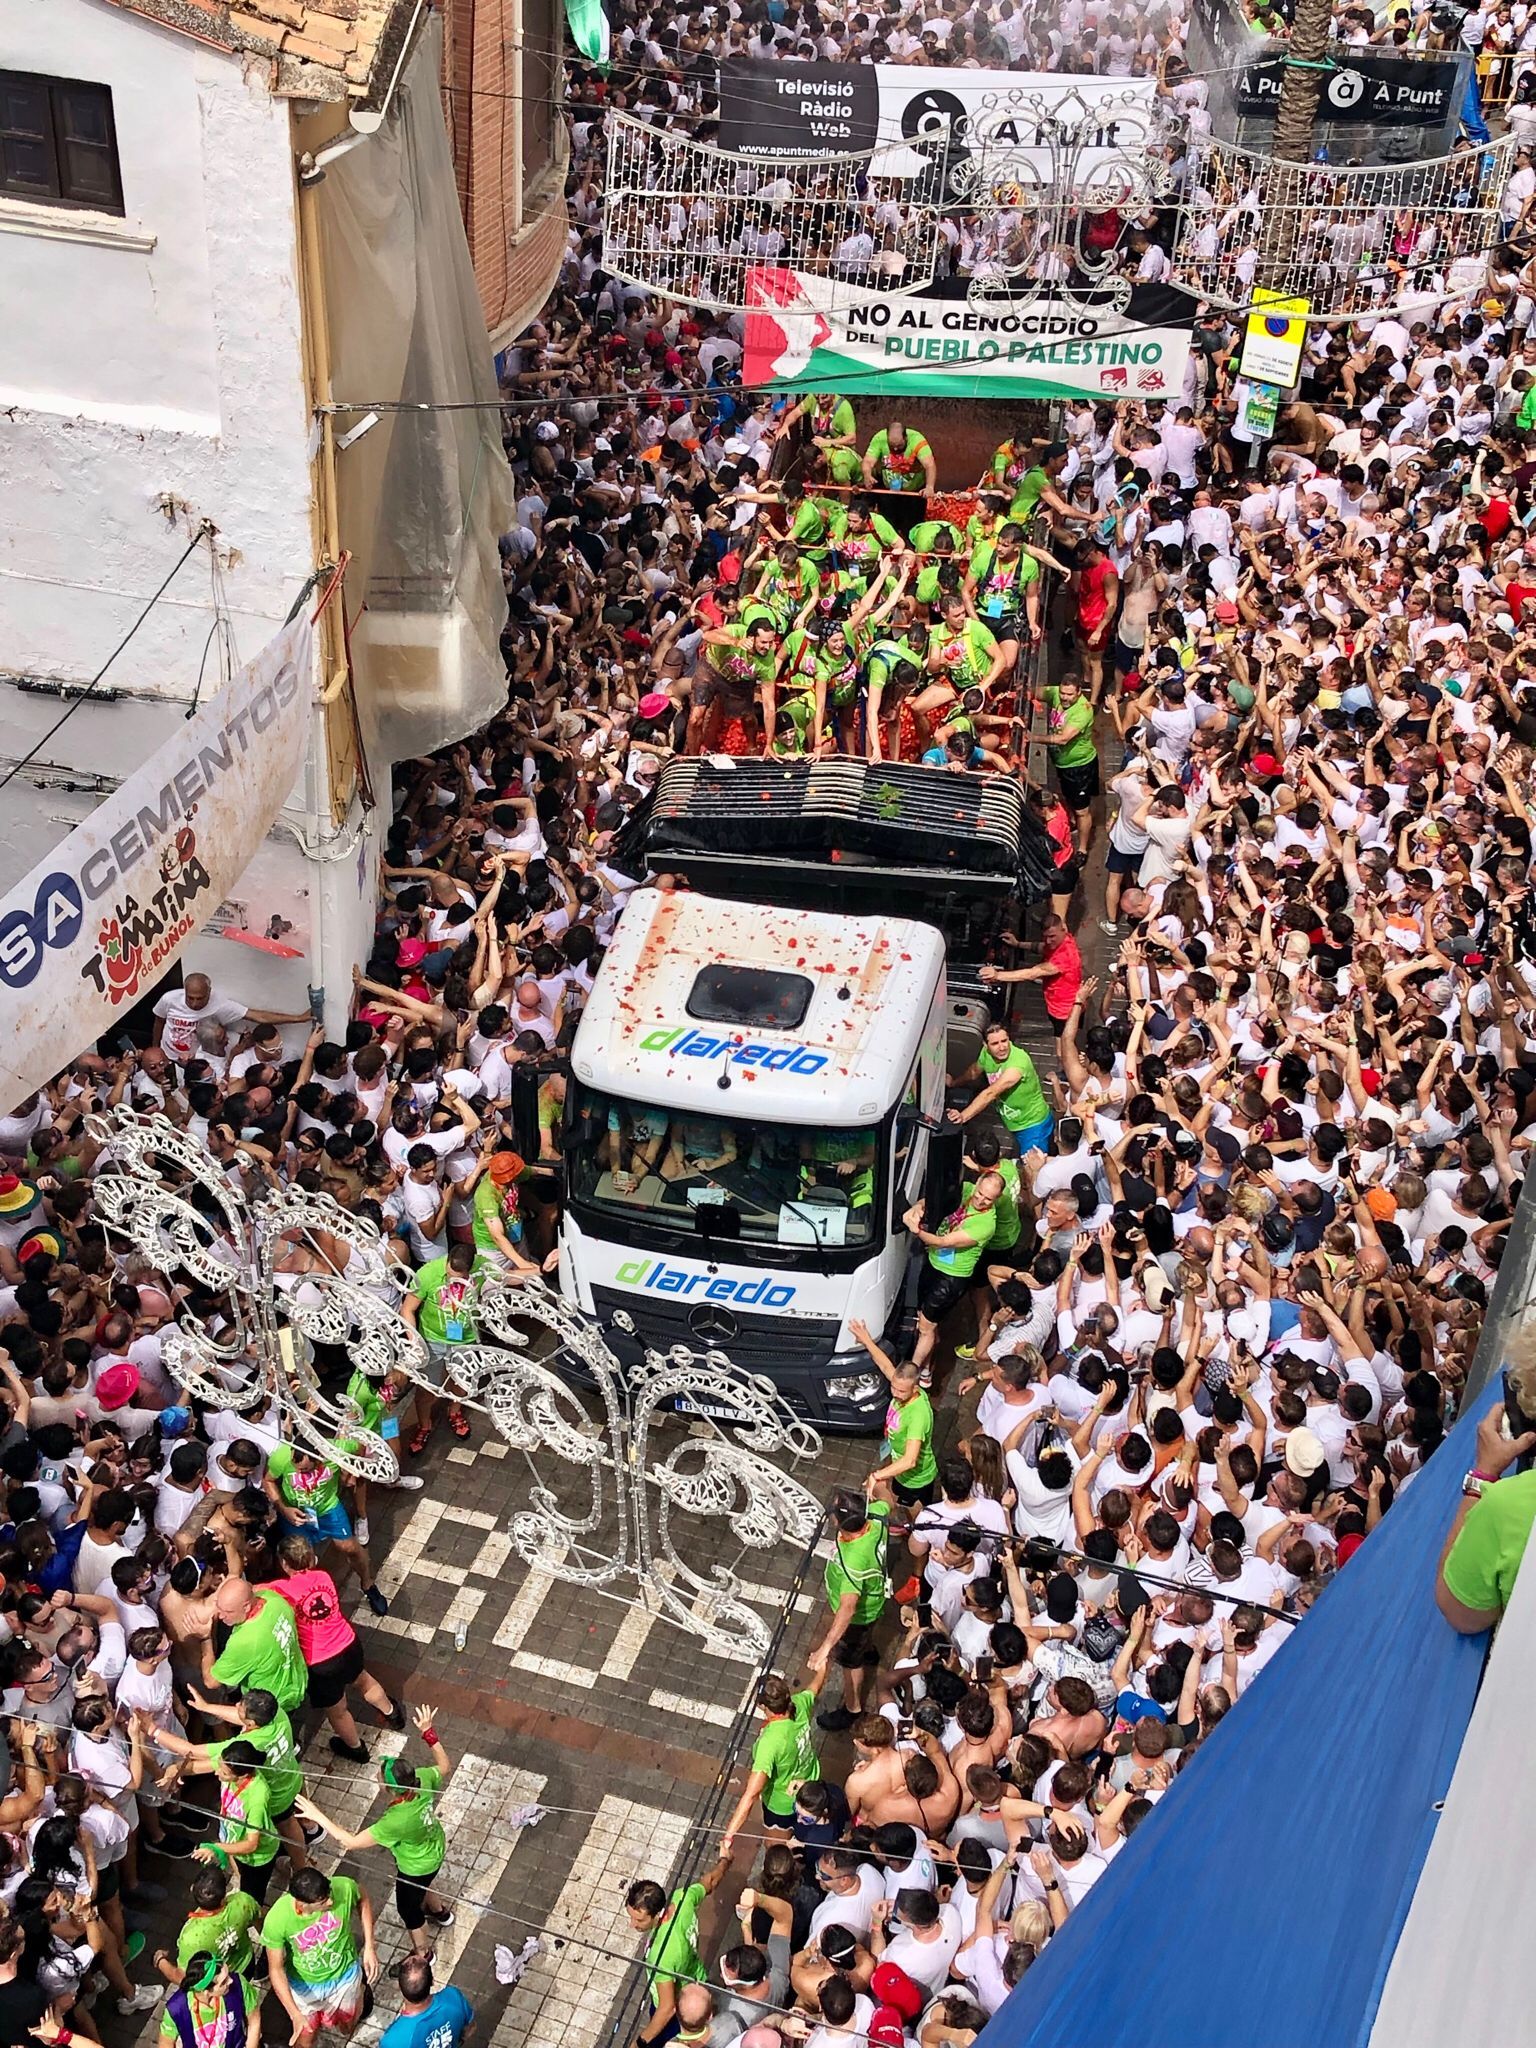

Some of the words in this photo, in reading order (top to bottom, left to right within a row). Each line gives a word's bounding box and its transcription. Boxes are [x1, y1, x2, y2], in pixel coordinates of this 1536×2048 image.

[775, 78, 854, 97] Televisió
[1258, 78, 1282, 94] Pu
[1397, 87, 1443, 105] Punt
[800, 101, 852, 118] Ràdio
[810, 121, 851, 138] Web
[848, 304, 890, 327] NO
[898, 310, 934, 328] AL
[942, 312, 1098, 336] GENOCIDIO
[846, 330, 879, 344] DEL
[884, 336, 1000, 362] PUEBLO
[1006, 341, 1163, 365] PALESTINO
[116, 895, 139, 924] LA
[141, 962, 154, 977] de
[151, 914, 195, 967] BUÑOL
[639, 1027, 829, 1076] dlaredo
[818, 1217, 828, 1237] 1
[616, 1259, 797, 1307] dlaredo
[266, 1735, 289, 1766] 25
[289, 1911, 337, 1946] TOM
[425, 2021, 451, 2043] STAFF
